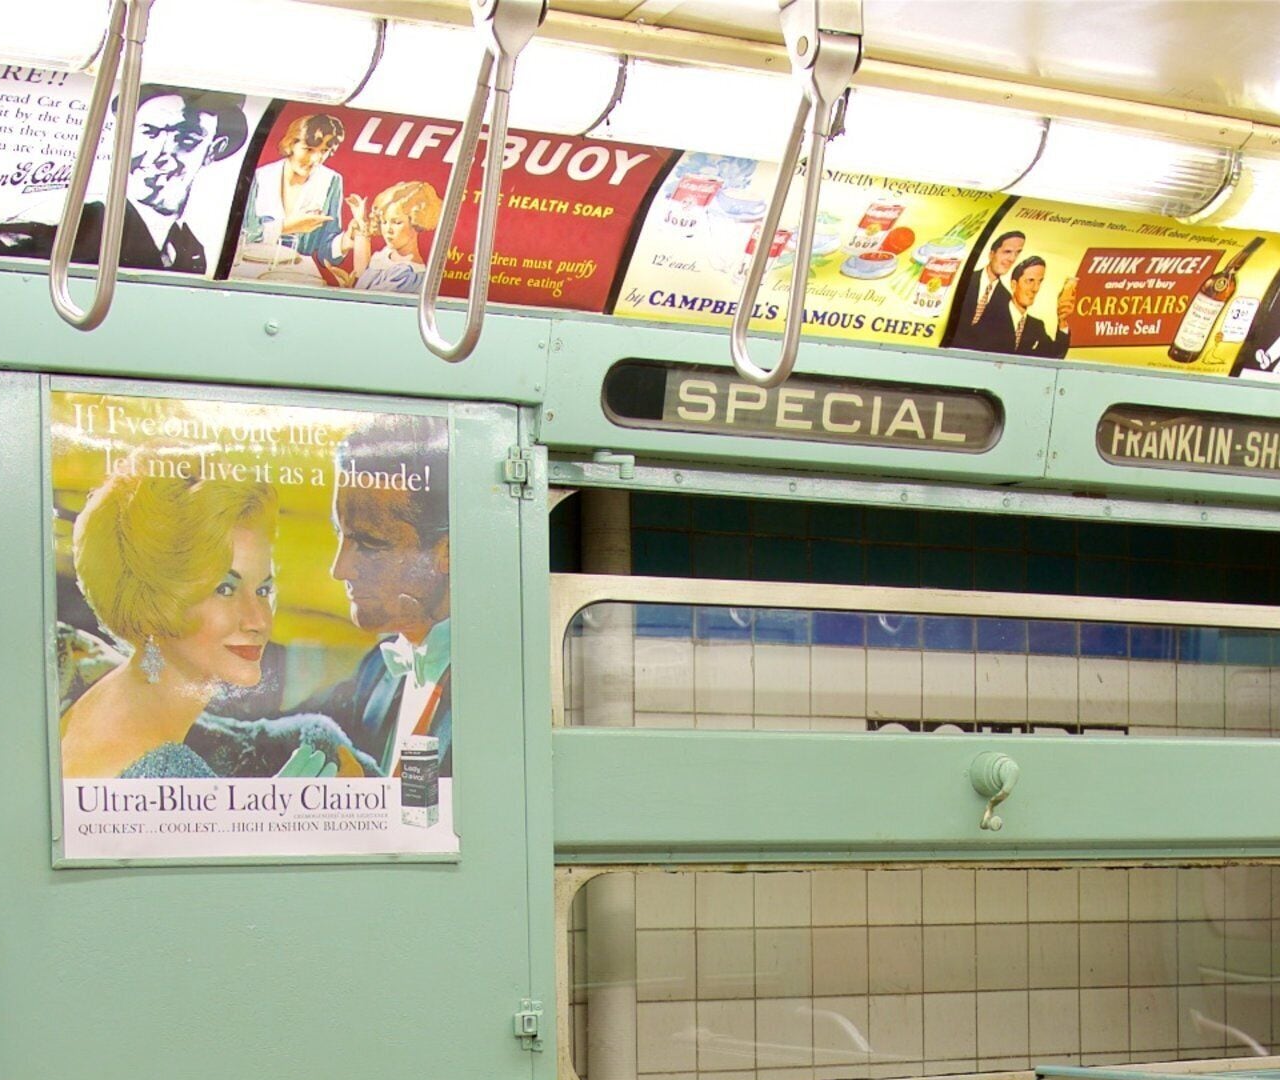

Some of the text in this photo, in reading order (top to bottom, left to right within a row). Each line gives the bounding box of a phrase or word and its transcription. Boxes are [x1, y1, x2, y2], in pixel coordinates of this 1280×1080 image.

[0, 93, 30, 105] read
[37, 96, 62, 108] Car
[15, 108, 32, 123] by
[38, 111, 60, 124] the
[20, 125, 47, 141] they
[881, 177, 950, 198] Vegetable
[508, 195, 569, 214] HEALTH
[572, 203, 615, 219] SOAP
[1016, 207, 1050, 221] THINK
[1049, 214, 1071, 224] about
[1136, 224, 1170, 237] THINK
[522, 255, 553, 270] must
[556, 259, 597, 279] purify
[1087, 255, 1211, 274] THINK TWICE!
[1105, 279, 1176, 291] and you'll buy
[624, 287, 647, 307] by
[872, 317, 936, 337] CHEFS
[1077, 295, 1189, 316] CARSTAIRS
[1095, 319, 1161, 336] White Seal
[676, 379, 967, 443] SPECIAL
[72, 404, 99, 432] If
[105, 407, 160, 436] I've
[163, 412, 222, 441] only
[231, 423, 281, 442] one
[104, 447, 431, 493] let me live it as a blonde!
[227, 785, 292, 817] Lady
[232, 821, 264, 834] HIGH
[268, 820, 319, 833] FASHION
[323, 820, 388, 832] BLONDING
